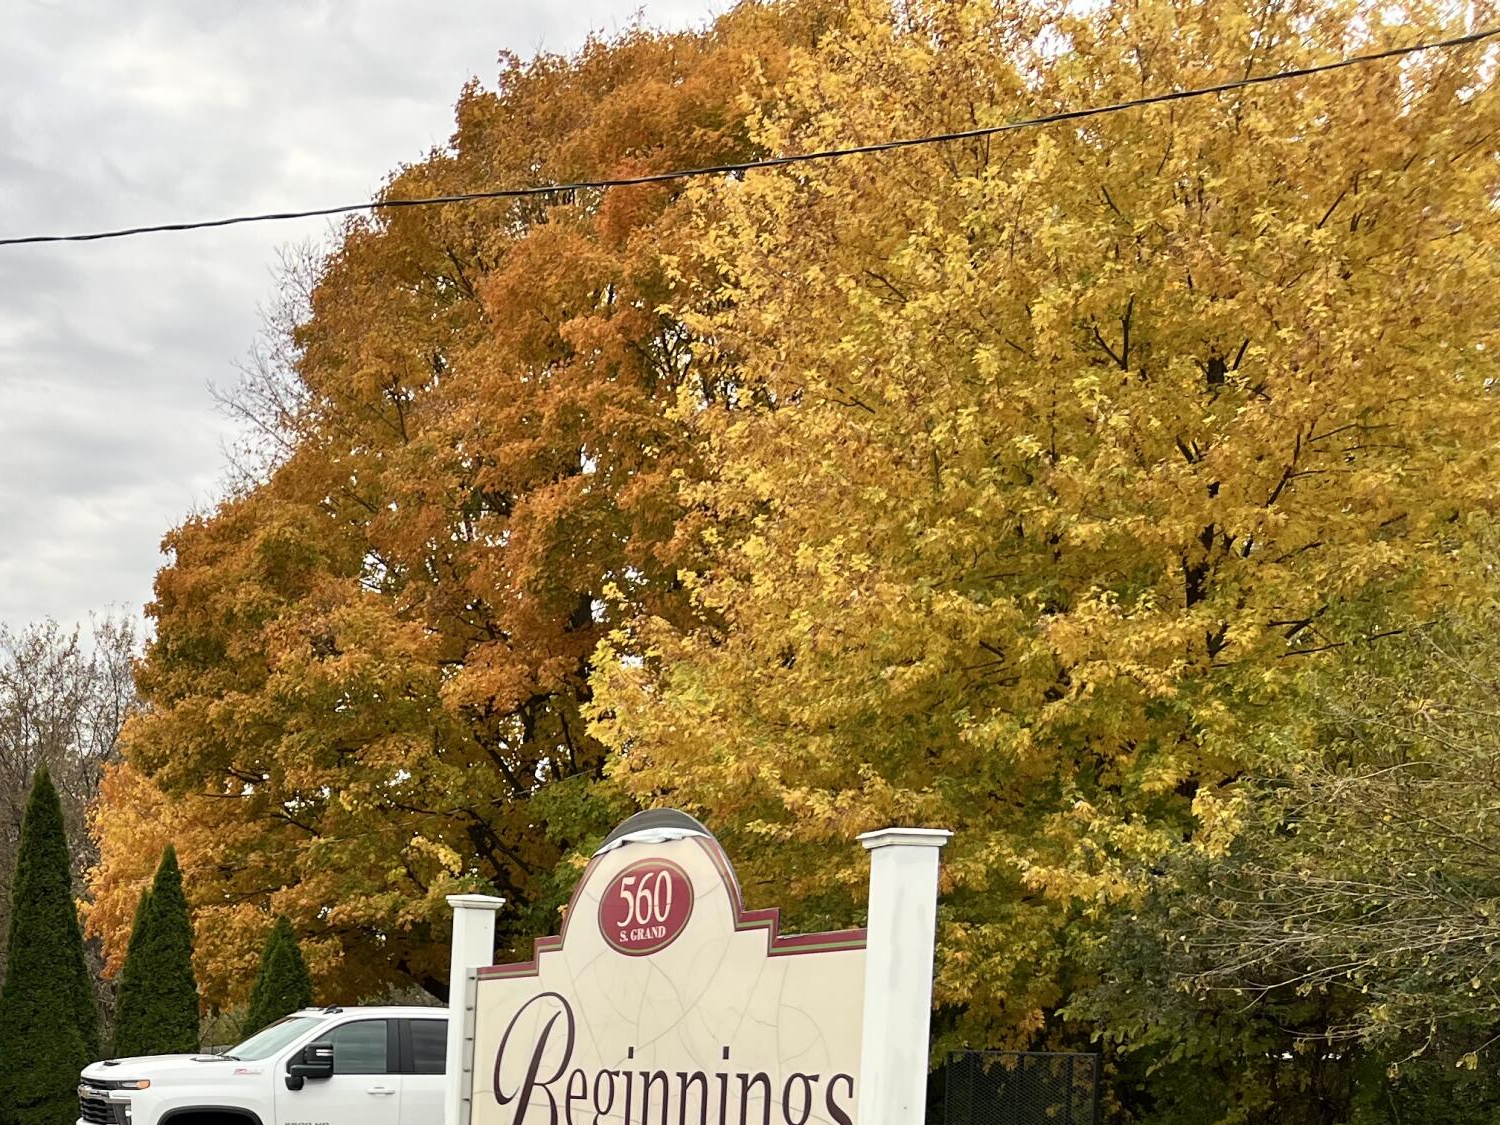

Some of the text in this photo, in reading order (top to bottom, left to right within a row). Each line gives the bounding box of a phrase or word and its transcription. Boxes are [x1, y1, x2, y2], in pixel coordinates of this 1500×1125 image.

[617, 870, 672, 927] 560
[619, 925, 667, 943] S. GRAND
